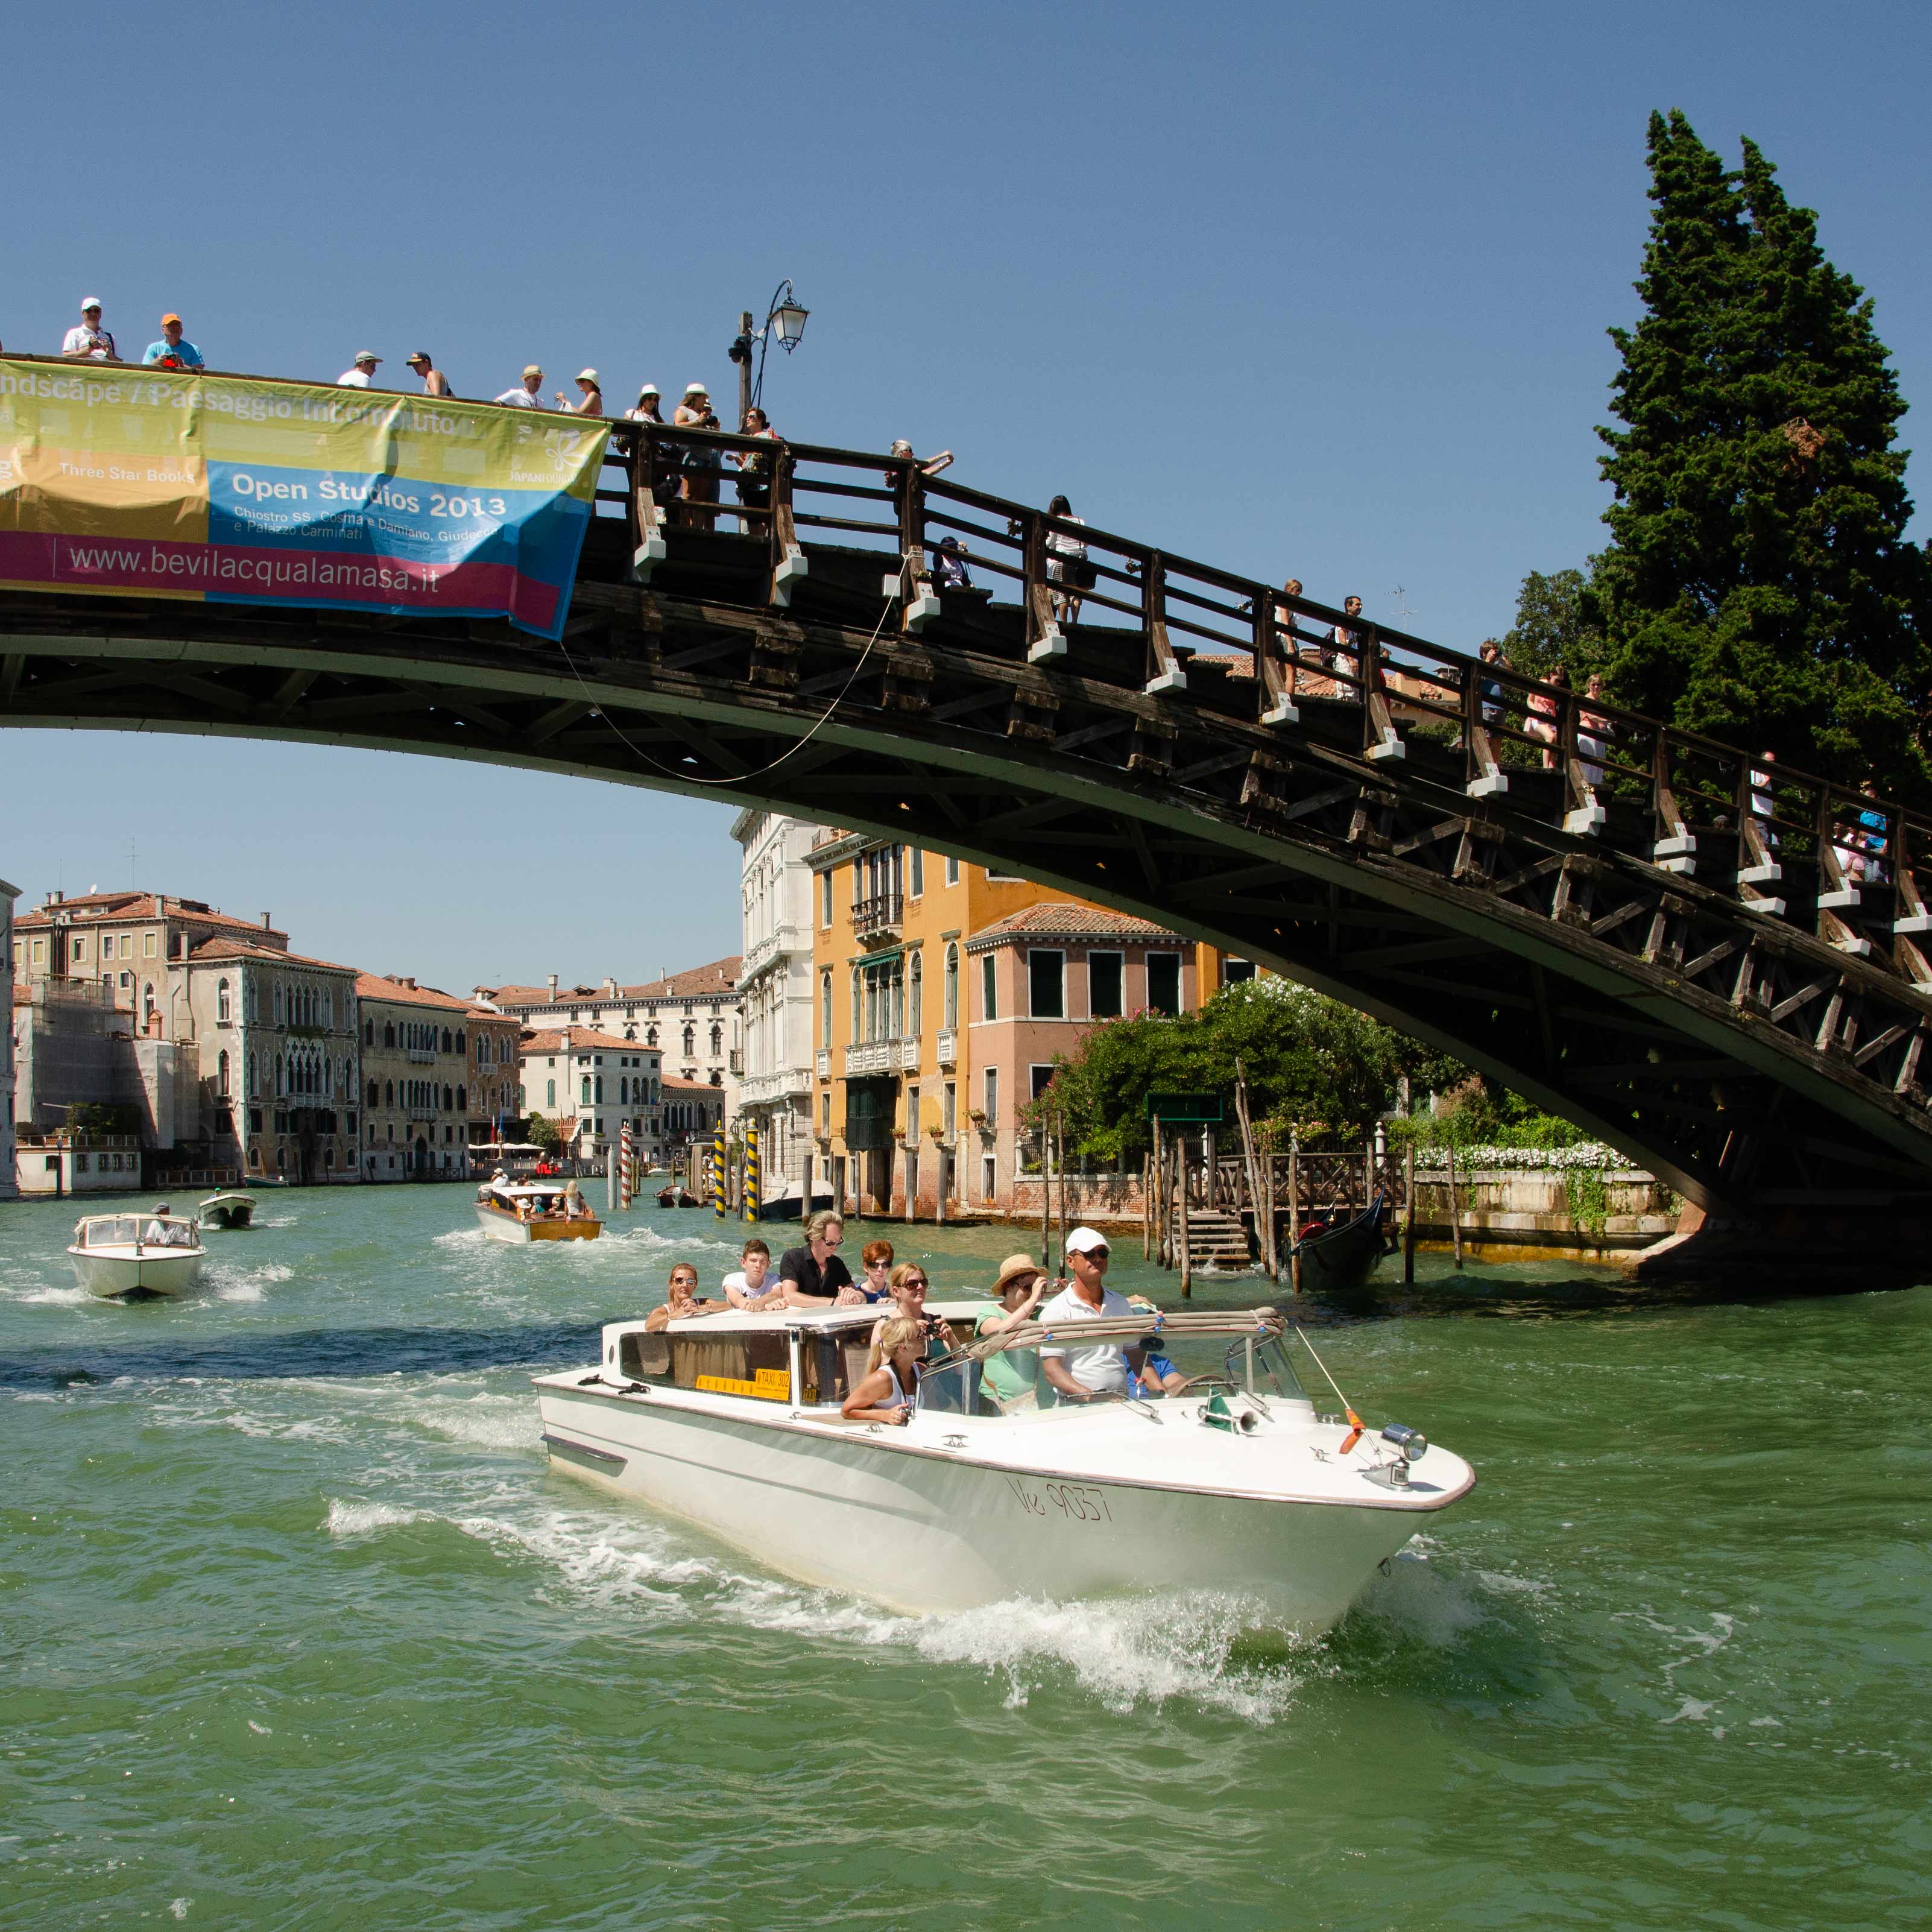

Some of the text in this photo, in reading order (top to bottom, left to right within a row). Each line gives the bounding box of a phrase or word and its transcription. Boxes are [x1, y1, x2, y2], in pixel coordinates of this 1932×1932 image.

[150, 382, 291, 421] Paesaggio
[58, 462, 195, 484] Three Star Books
[232, 473, 507, 517] Open Studios 2013
[234, 506, 497, 541] Chiostro SS. Cosma e Damiano, Giudecca
[234, 520, 362, 540] e Palazzo Carminati
[70, 546, 440, 593] www.bevilacqualamasa.it
[762, 1371, 789, 1387] TAXI 302
